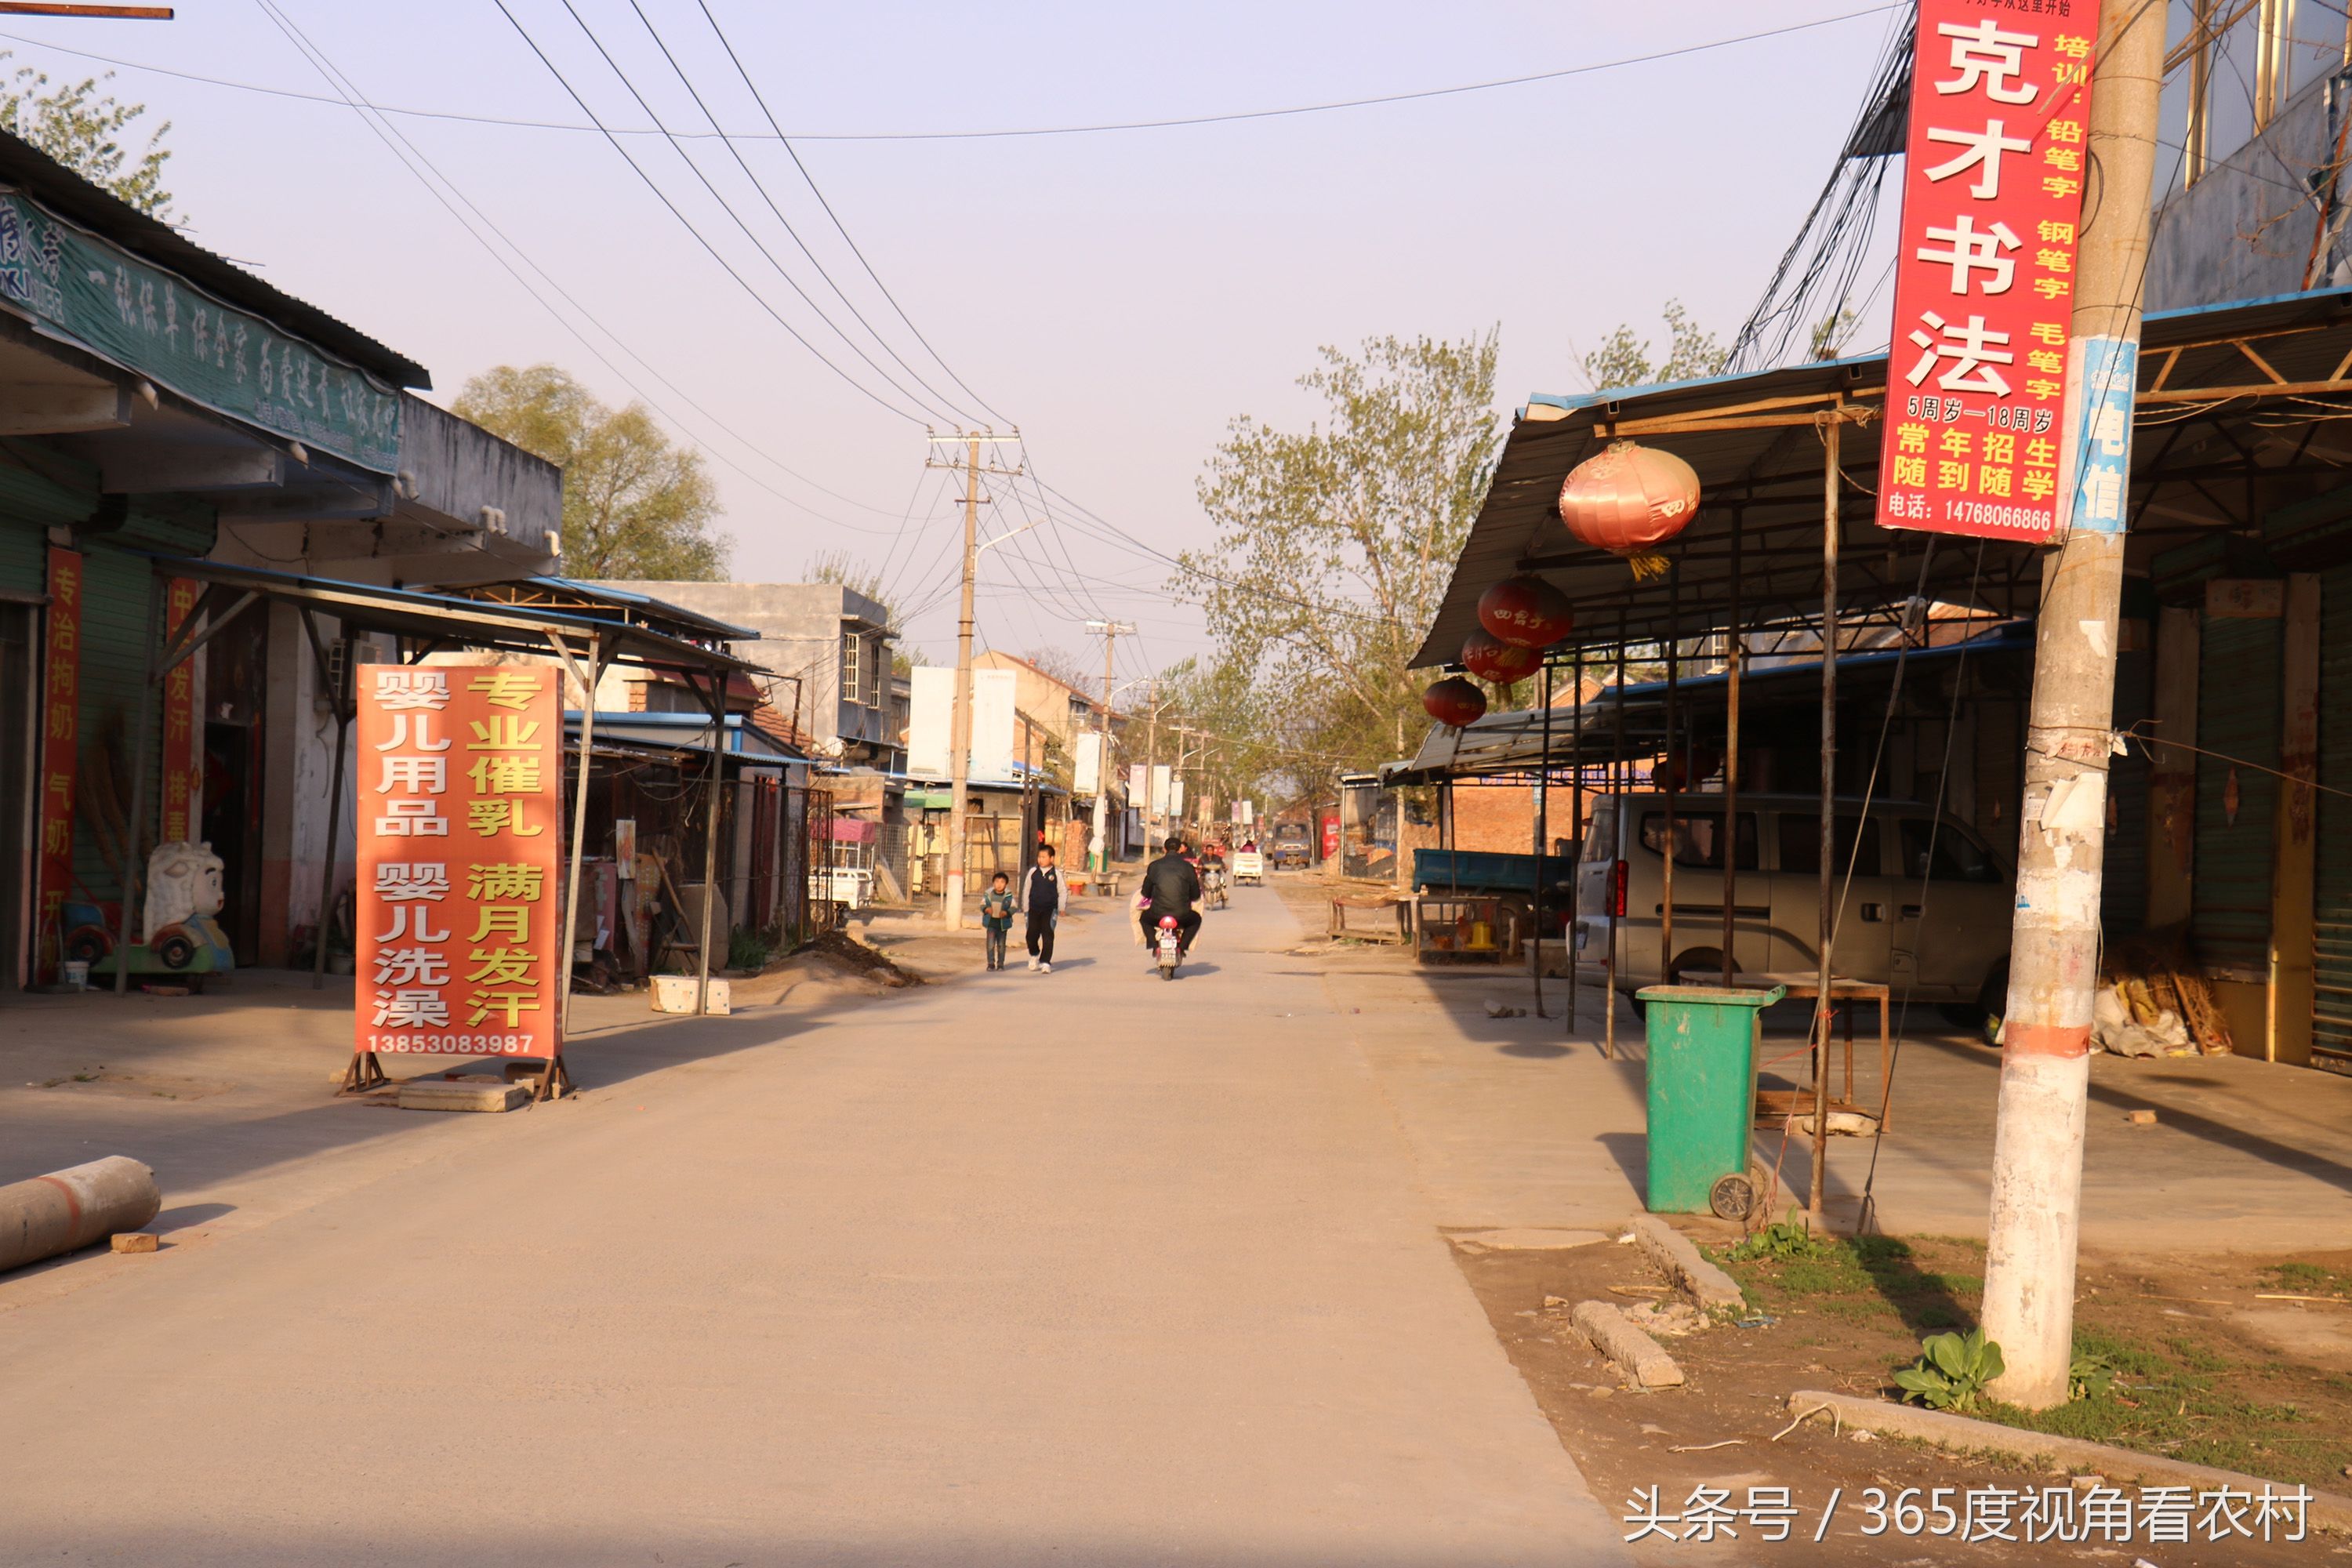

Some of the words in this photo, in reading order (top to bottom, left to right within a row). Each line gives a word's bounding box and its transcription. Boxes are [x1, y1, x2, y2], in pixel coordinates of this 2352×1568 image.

[1966, 0, 2071, 17] 字从这里开始
[1905, 20, 2038, 398] 克才书法
[2034, 220, 2074, 299] 钢笔字
[2025, 322, 2067, 401] 毛笔字
[1893, 456, 2053, 501] 随到随学
[1896, 423, 2056, 468] 常年招生
[2082, 402, 2125, 521] 电信
[50, 567, 76, 740] 专治拘奶
[374, 672, 452, 837] 婴儿用品
[466, 672, 543, 837] 专业催乳
[46, 772, 71, 856] 气奶
[168, 769, 187, 841] 排毒
[372, 862, 450, 1028] 婴儿洗澡
[465, 862, 543, 1028] 满月发汗
[368, 1035, 534, 1054] 13853083987
